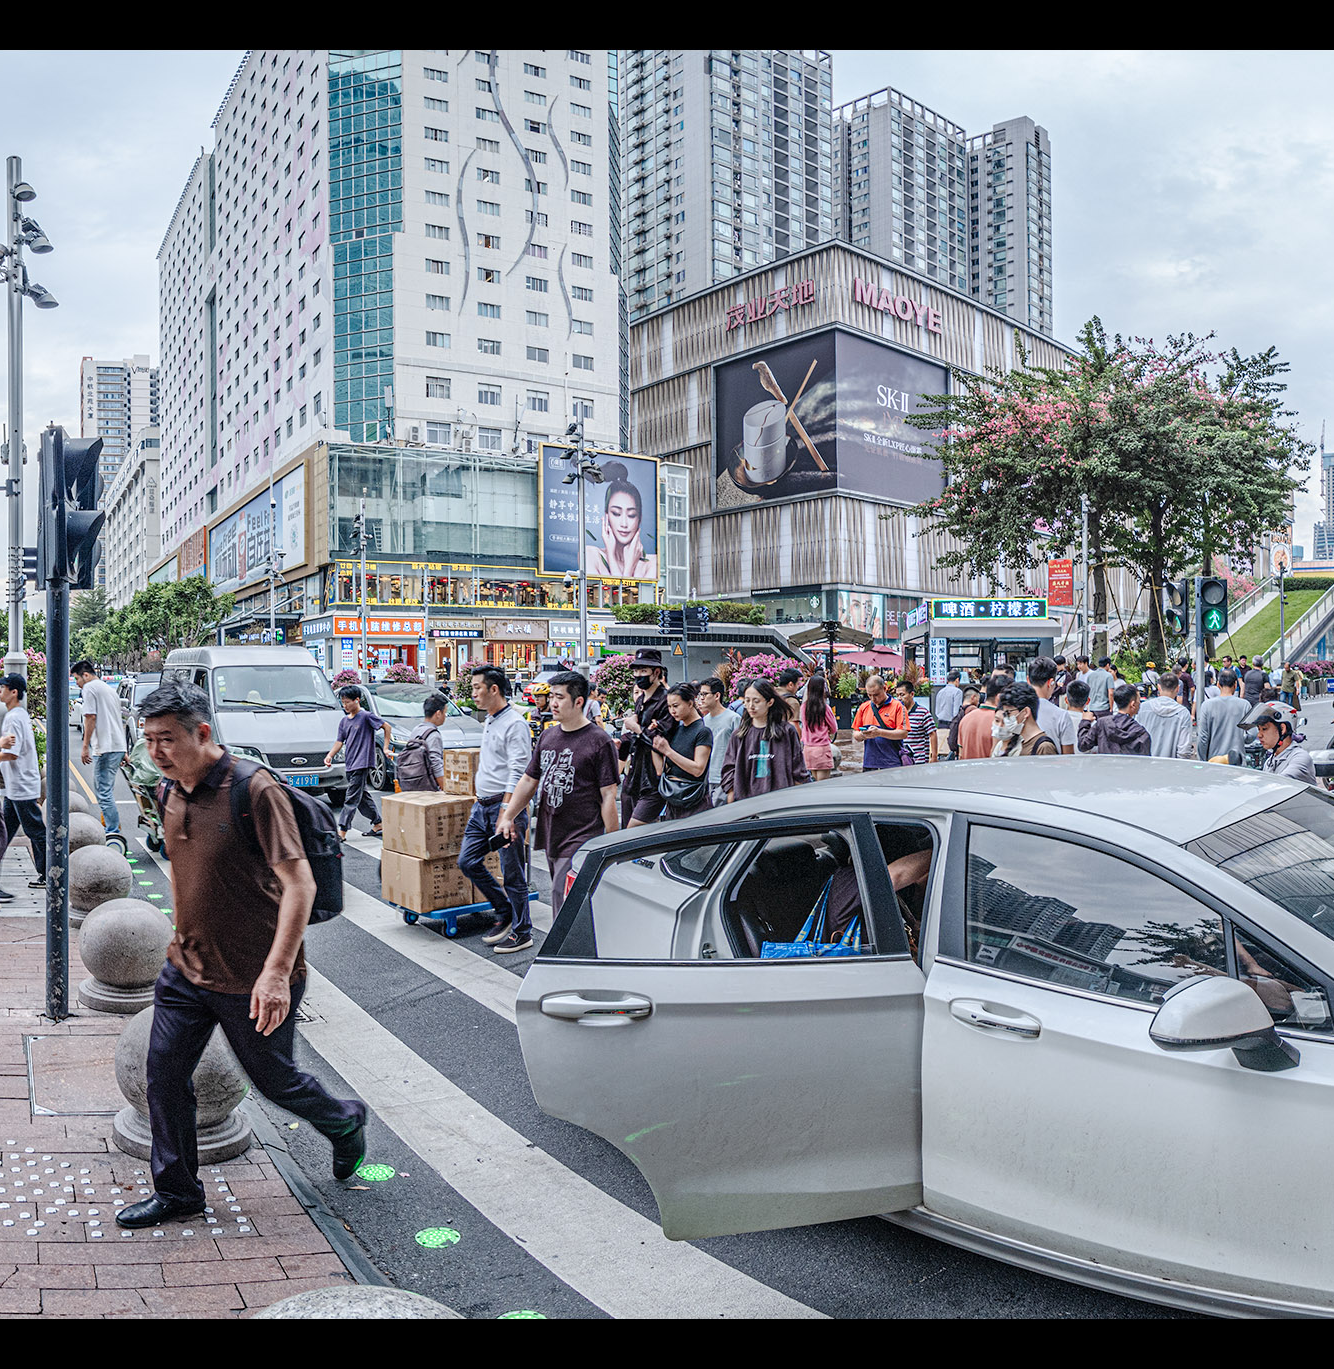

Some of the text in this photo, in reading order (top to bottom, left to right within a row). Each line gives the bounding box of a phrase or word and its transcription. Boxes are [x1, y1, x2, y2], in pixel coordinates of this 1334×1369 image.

[725, 279, 815, 332] 茂业天地
[854, 276, 943, 335] MAOYE
[505, 624, 532, 634] 周六福
